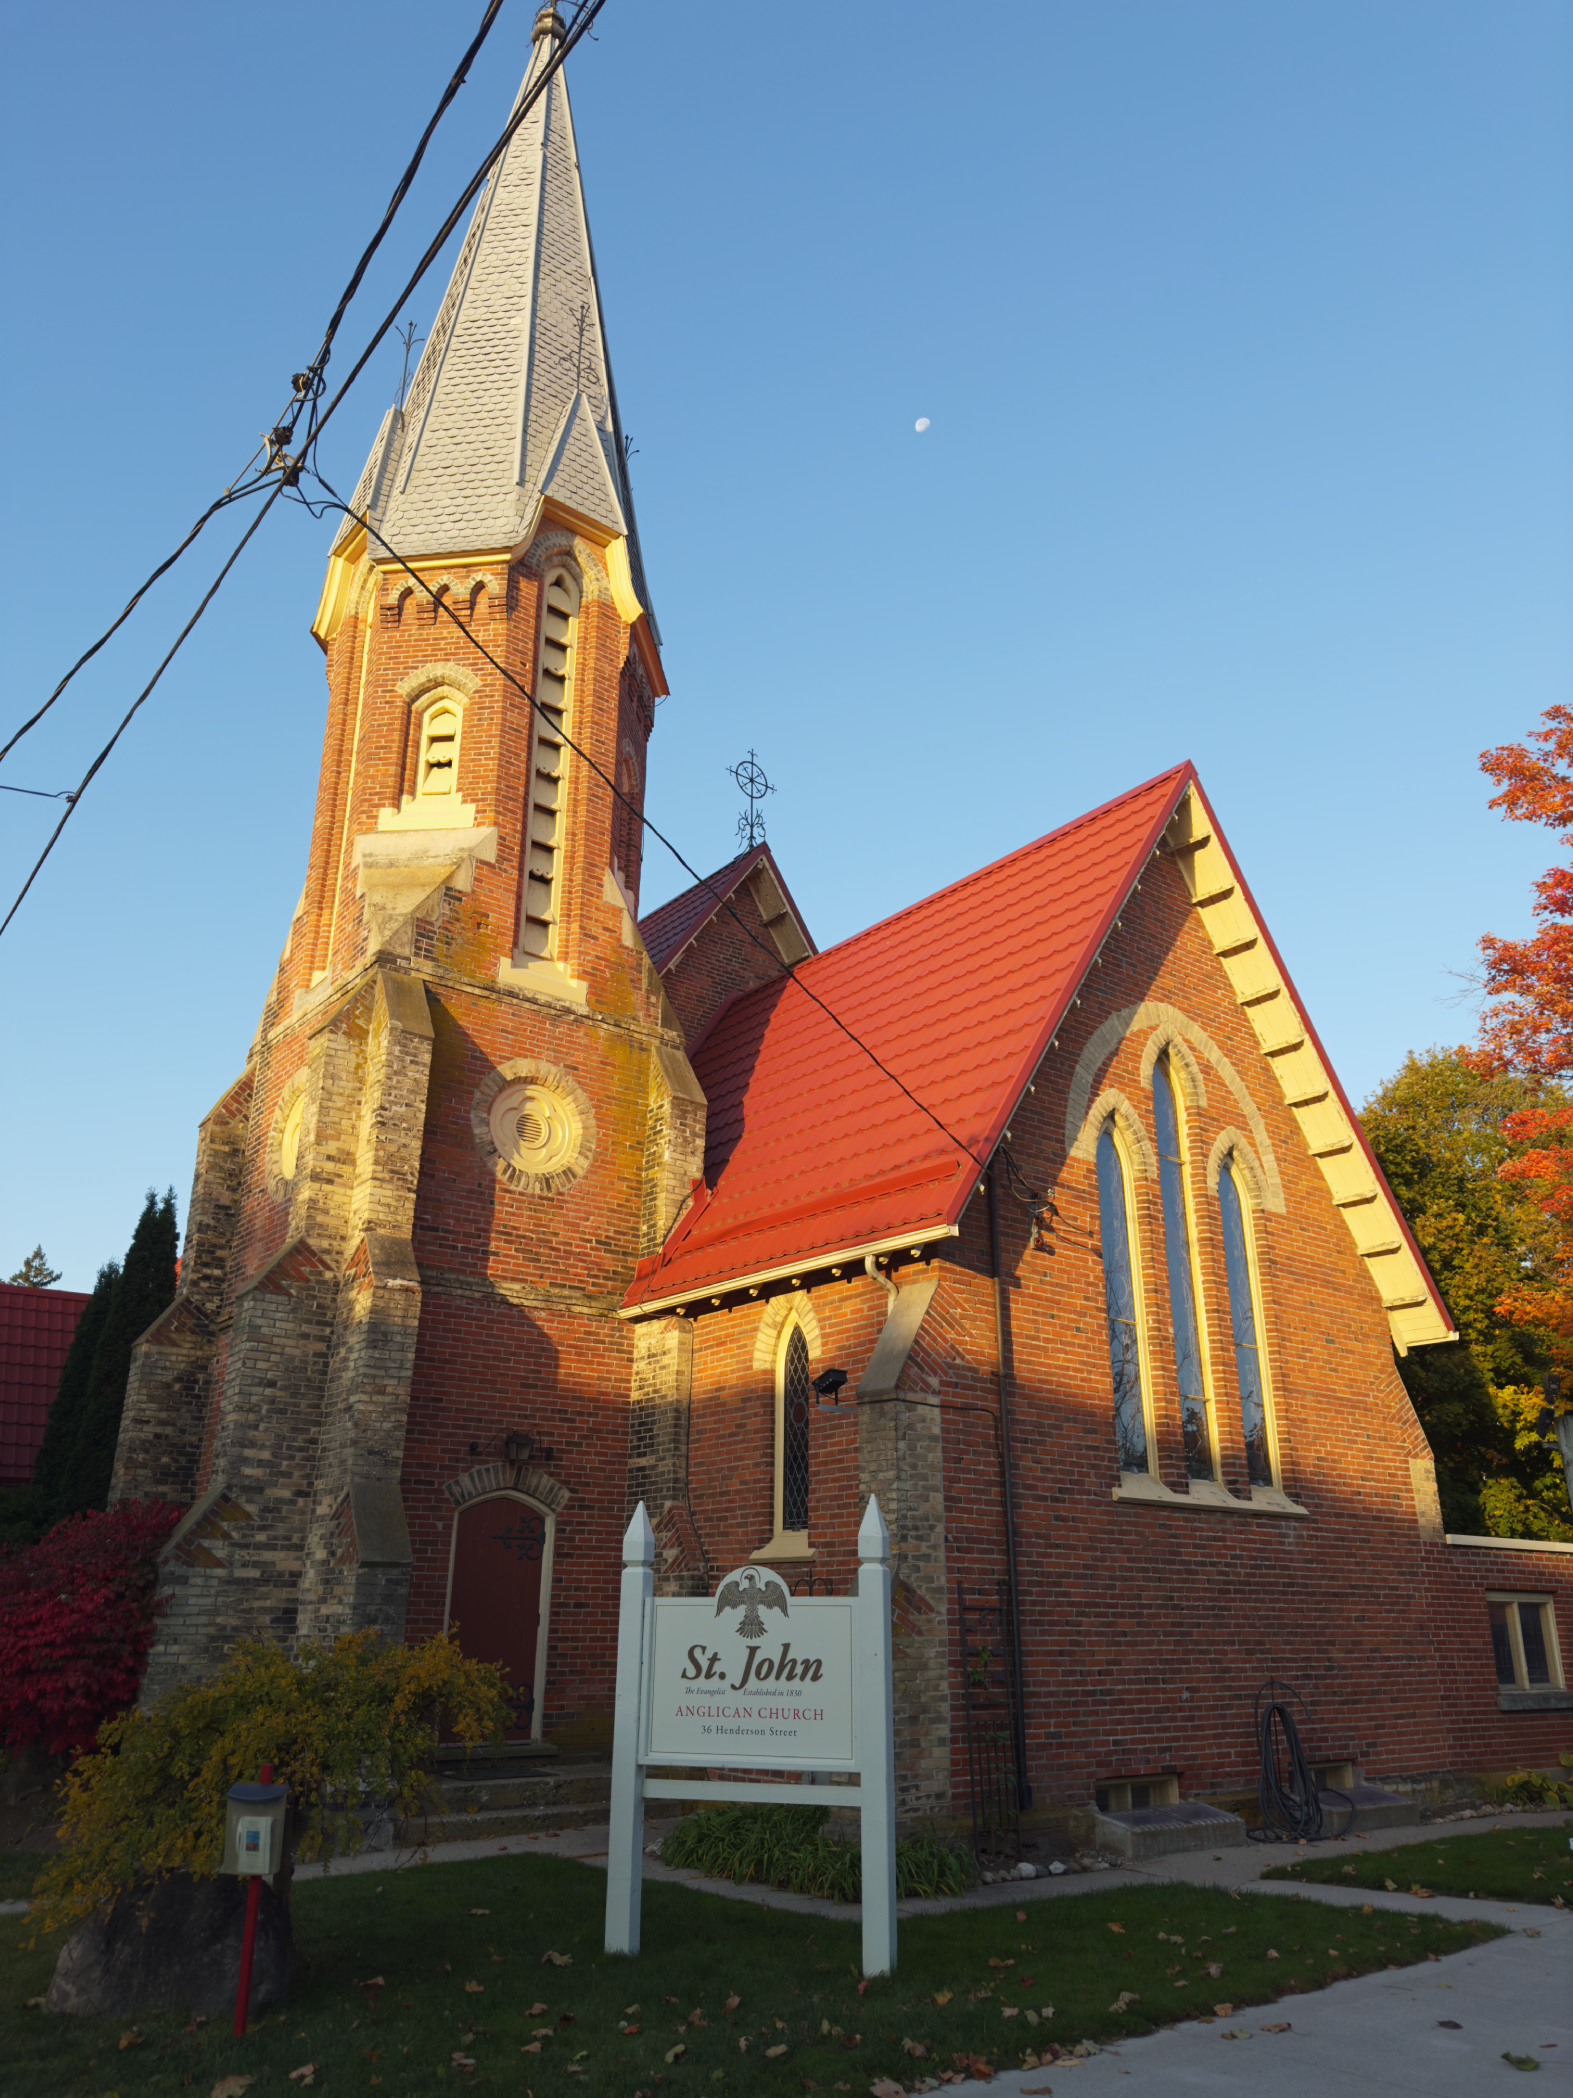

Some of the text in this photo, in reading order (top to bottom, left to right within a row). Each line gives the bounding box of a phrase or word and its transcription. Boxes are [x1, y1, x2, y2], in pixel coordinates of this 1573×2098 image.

[680, 1642, 824, 1691] St. John
[684, 1686, 727, 1698] The Evangelist
[742, 1688, 803, 1698] Established in 1830
[674, 1705, 825, 1721] ANGLICAN CHURCH
[700, 1724, 798, 1737] 36 Henderson Street
